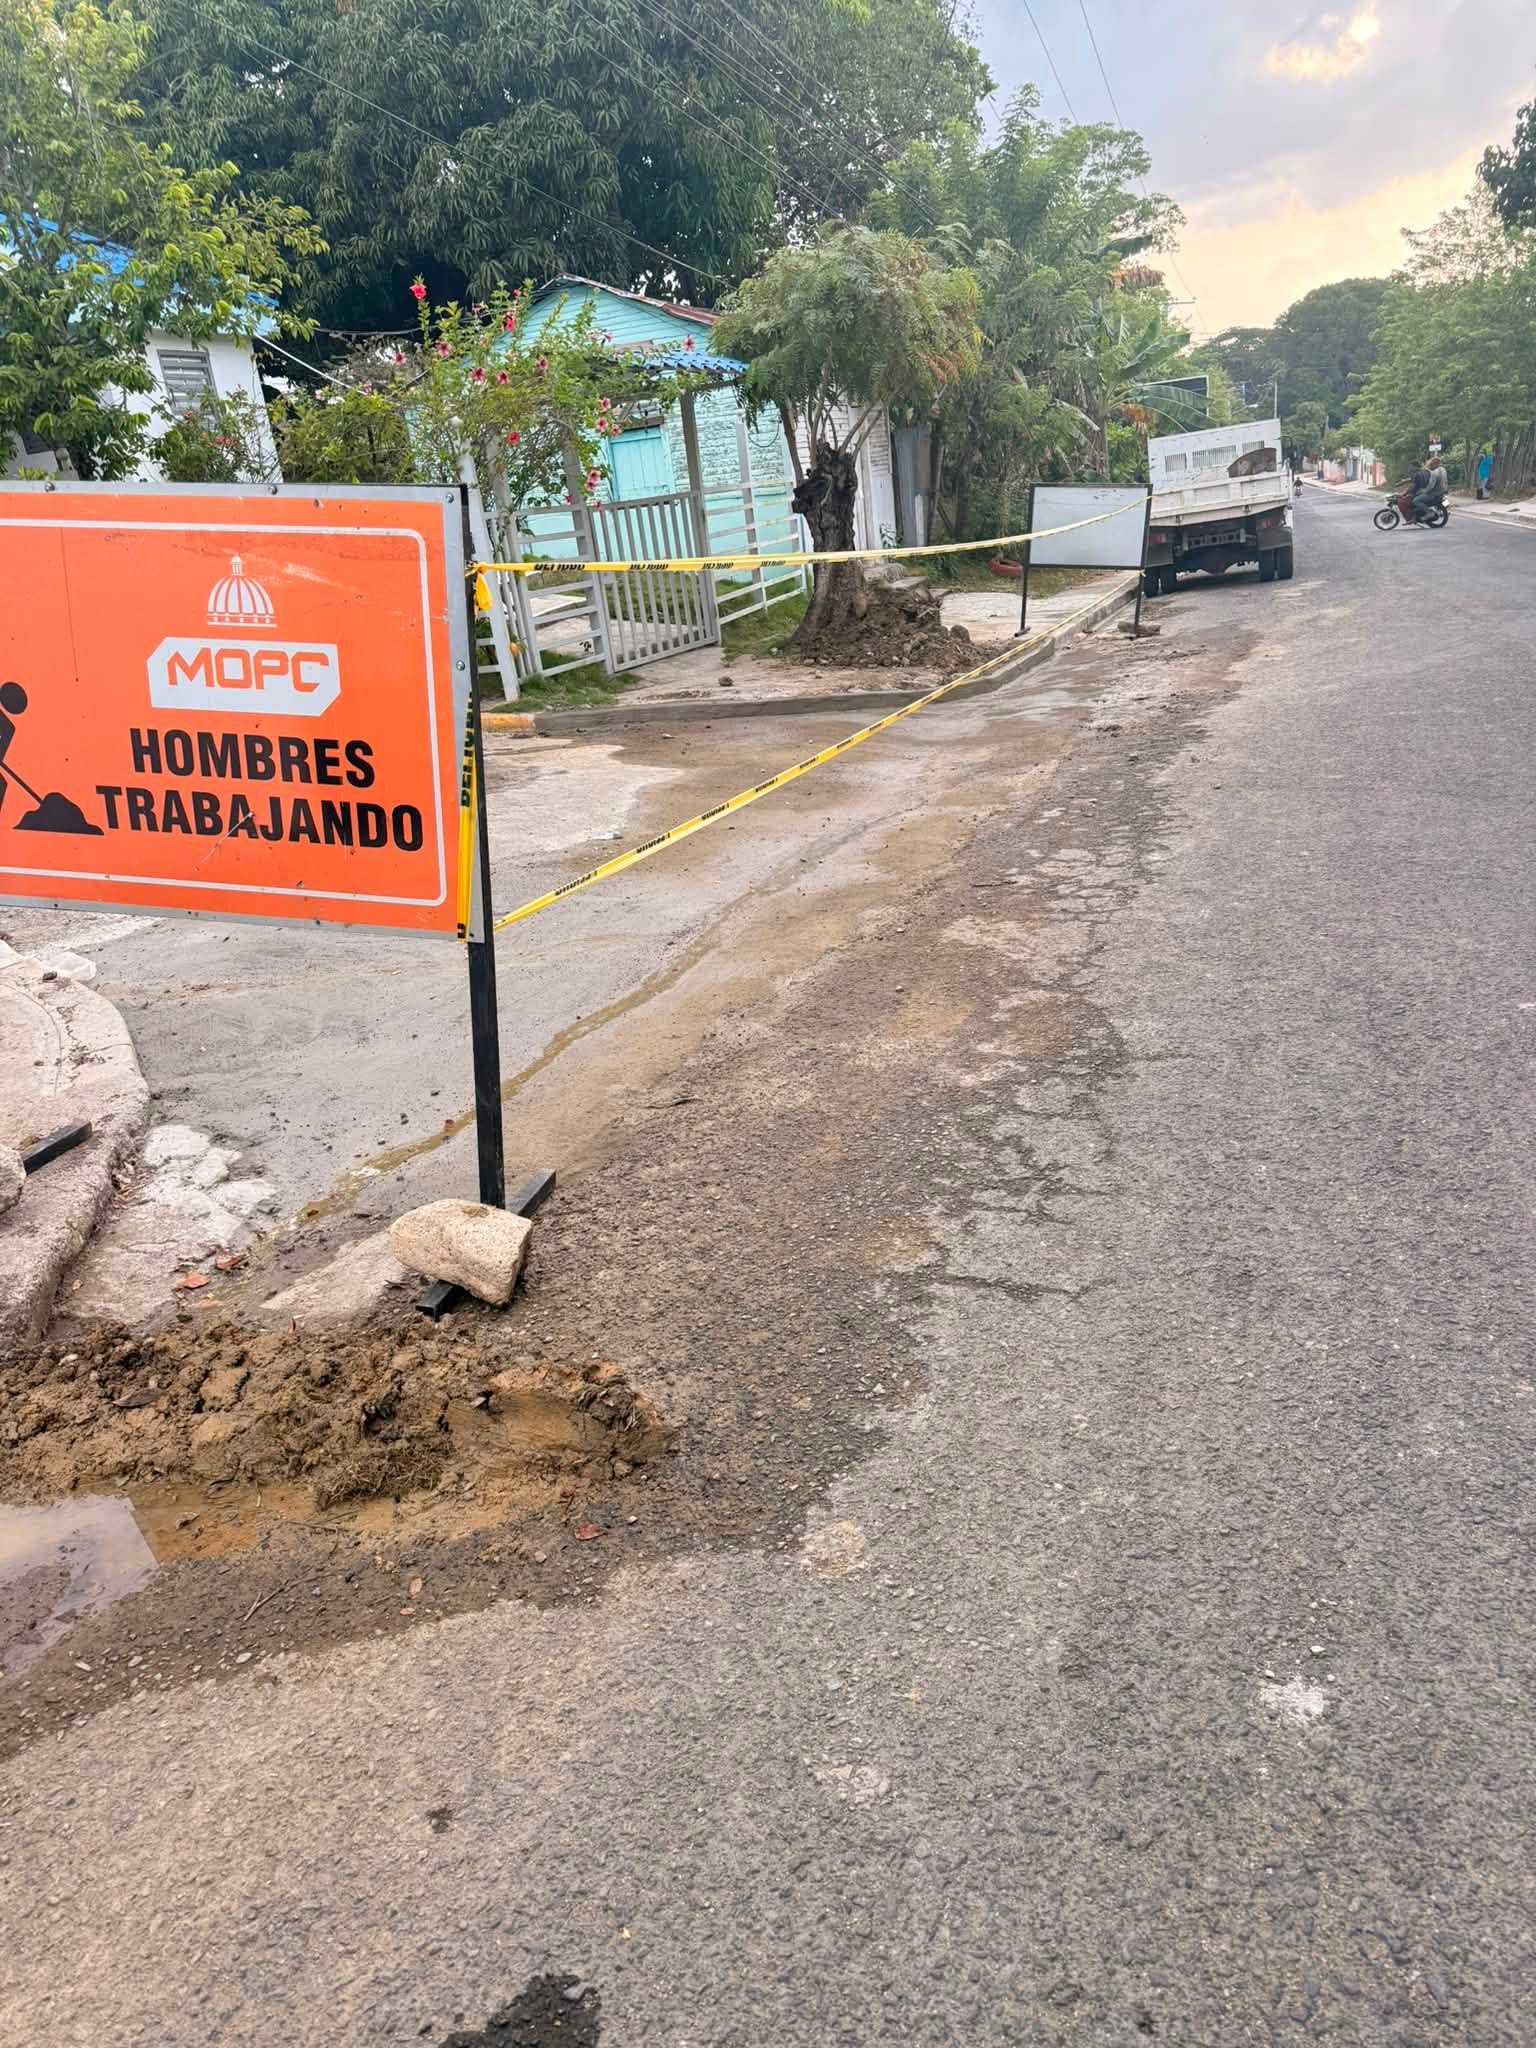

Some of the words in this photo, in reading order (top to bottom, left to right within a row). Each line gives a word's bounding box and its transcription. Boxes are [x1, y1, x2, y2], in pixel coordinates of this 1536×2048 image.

[167, 647, 329, 693] MOPC
[130, 727, 375, 788] HOMBRES
[96, 785, 423, 852] TRABAJANDO
